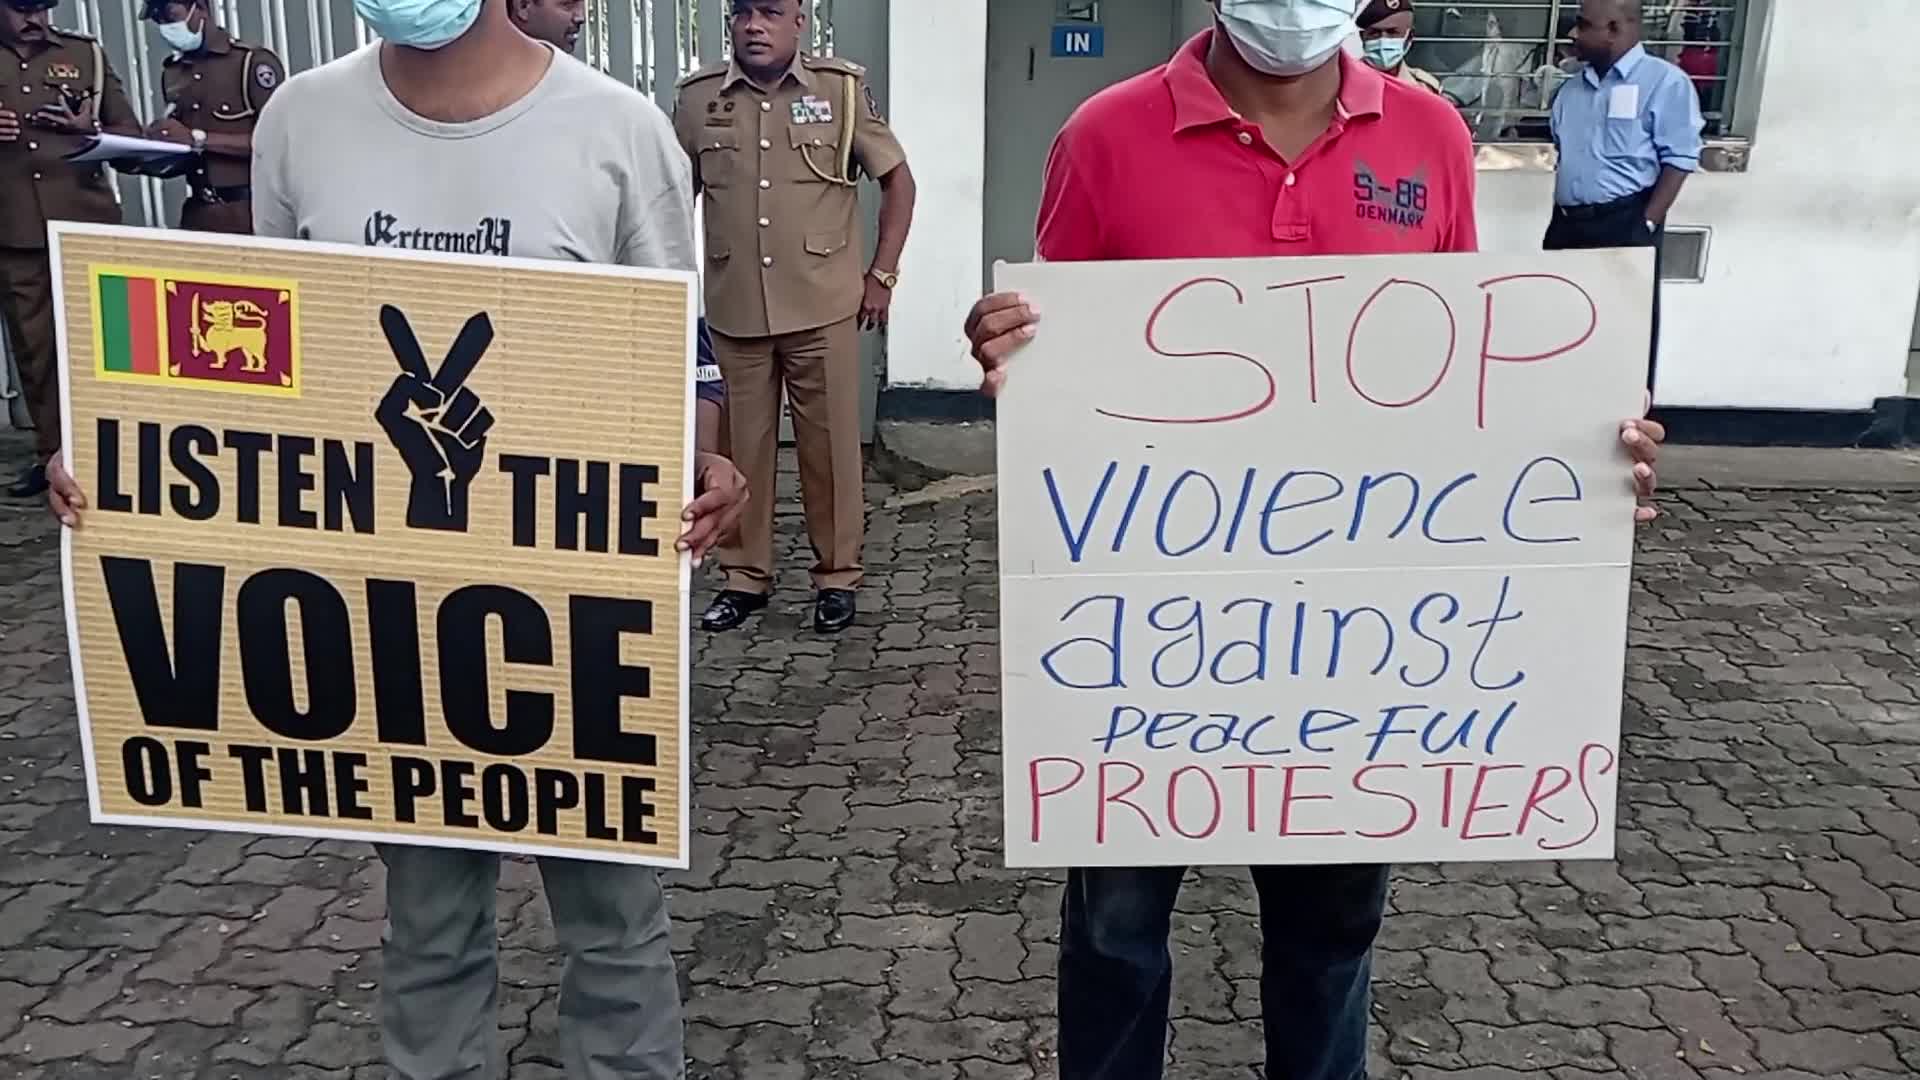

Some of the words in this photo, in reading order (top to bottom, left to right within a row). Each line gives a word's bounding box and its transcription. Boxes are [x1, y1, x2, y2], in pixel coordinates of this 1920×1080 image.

[1066, 32, 1090, 52] IN
[1355, 203, 1424, 229] DENMARK
[1095, 274, 1597, 429] STOP
[97, 418, 375, 534] LISTEN
[499, 454, 659, 557] THE
[100, 556, 657, 767] VOICE
[1040, 575, 1526, 690] against
[122, 735, 212, 809] OF
[228, 745, 373, 821] THE
[391, 756, 658, 845] PEOPLE
[1029, 742, 1615, 851] PROTESTERS
